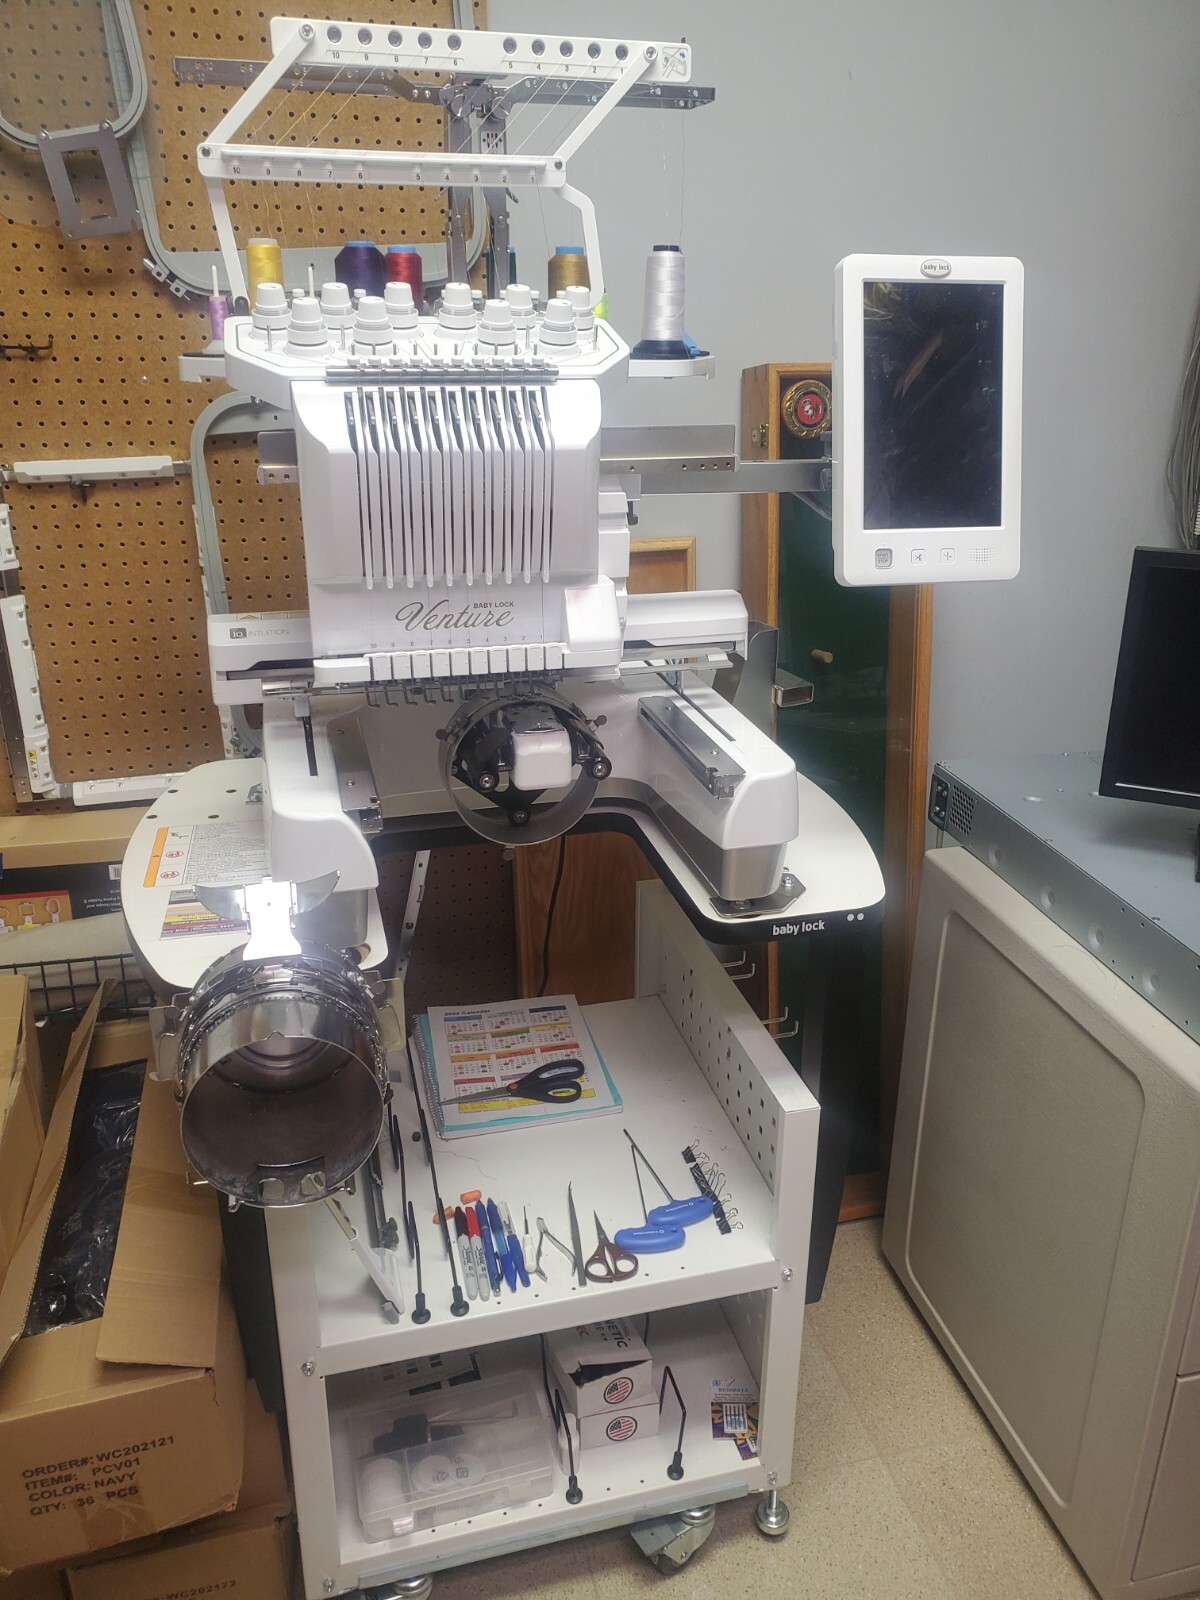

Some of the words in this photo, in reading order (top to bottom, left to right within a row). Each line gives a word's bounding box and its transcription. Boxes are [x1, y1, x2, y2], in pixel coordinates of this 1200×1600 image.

[332, 52, 340, 60] 10
[394, 55, 399, 63] 8
[564, 64, 569, 72] 3
[232, 166, 241, 174] 10
[395, 600, 514, 631] Venture
[772, 923, 800, 936] baby
[802, 920, 825, 932] lock
[22, 1456, 94, 1478] ORDER#:
[96, 1436, 174, 1462] WC202121
[25, 1473, 78, 1490] ITEM#:
[92, 1458, 140, 1476] PCV01
[29, 1483, 91, 1502] COLOR:
[94, 1471, 136, 1488] NAVY
[29, 1502, 66, 1516] QTY:
[78, 1496, 95, 1507] 36
[106, 1485, 139, 1500] PCS
